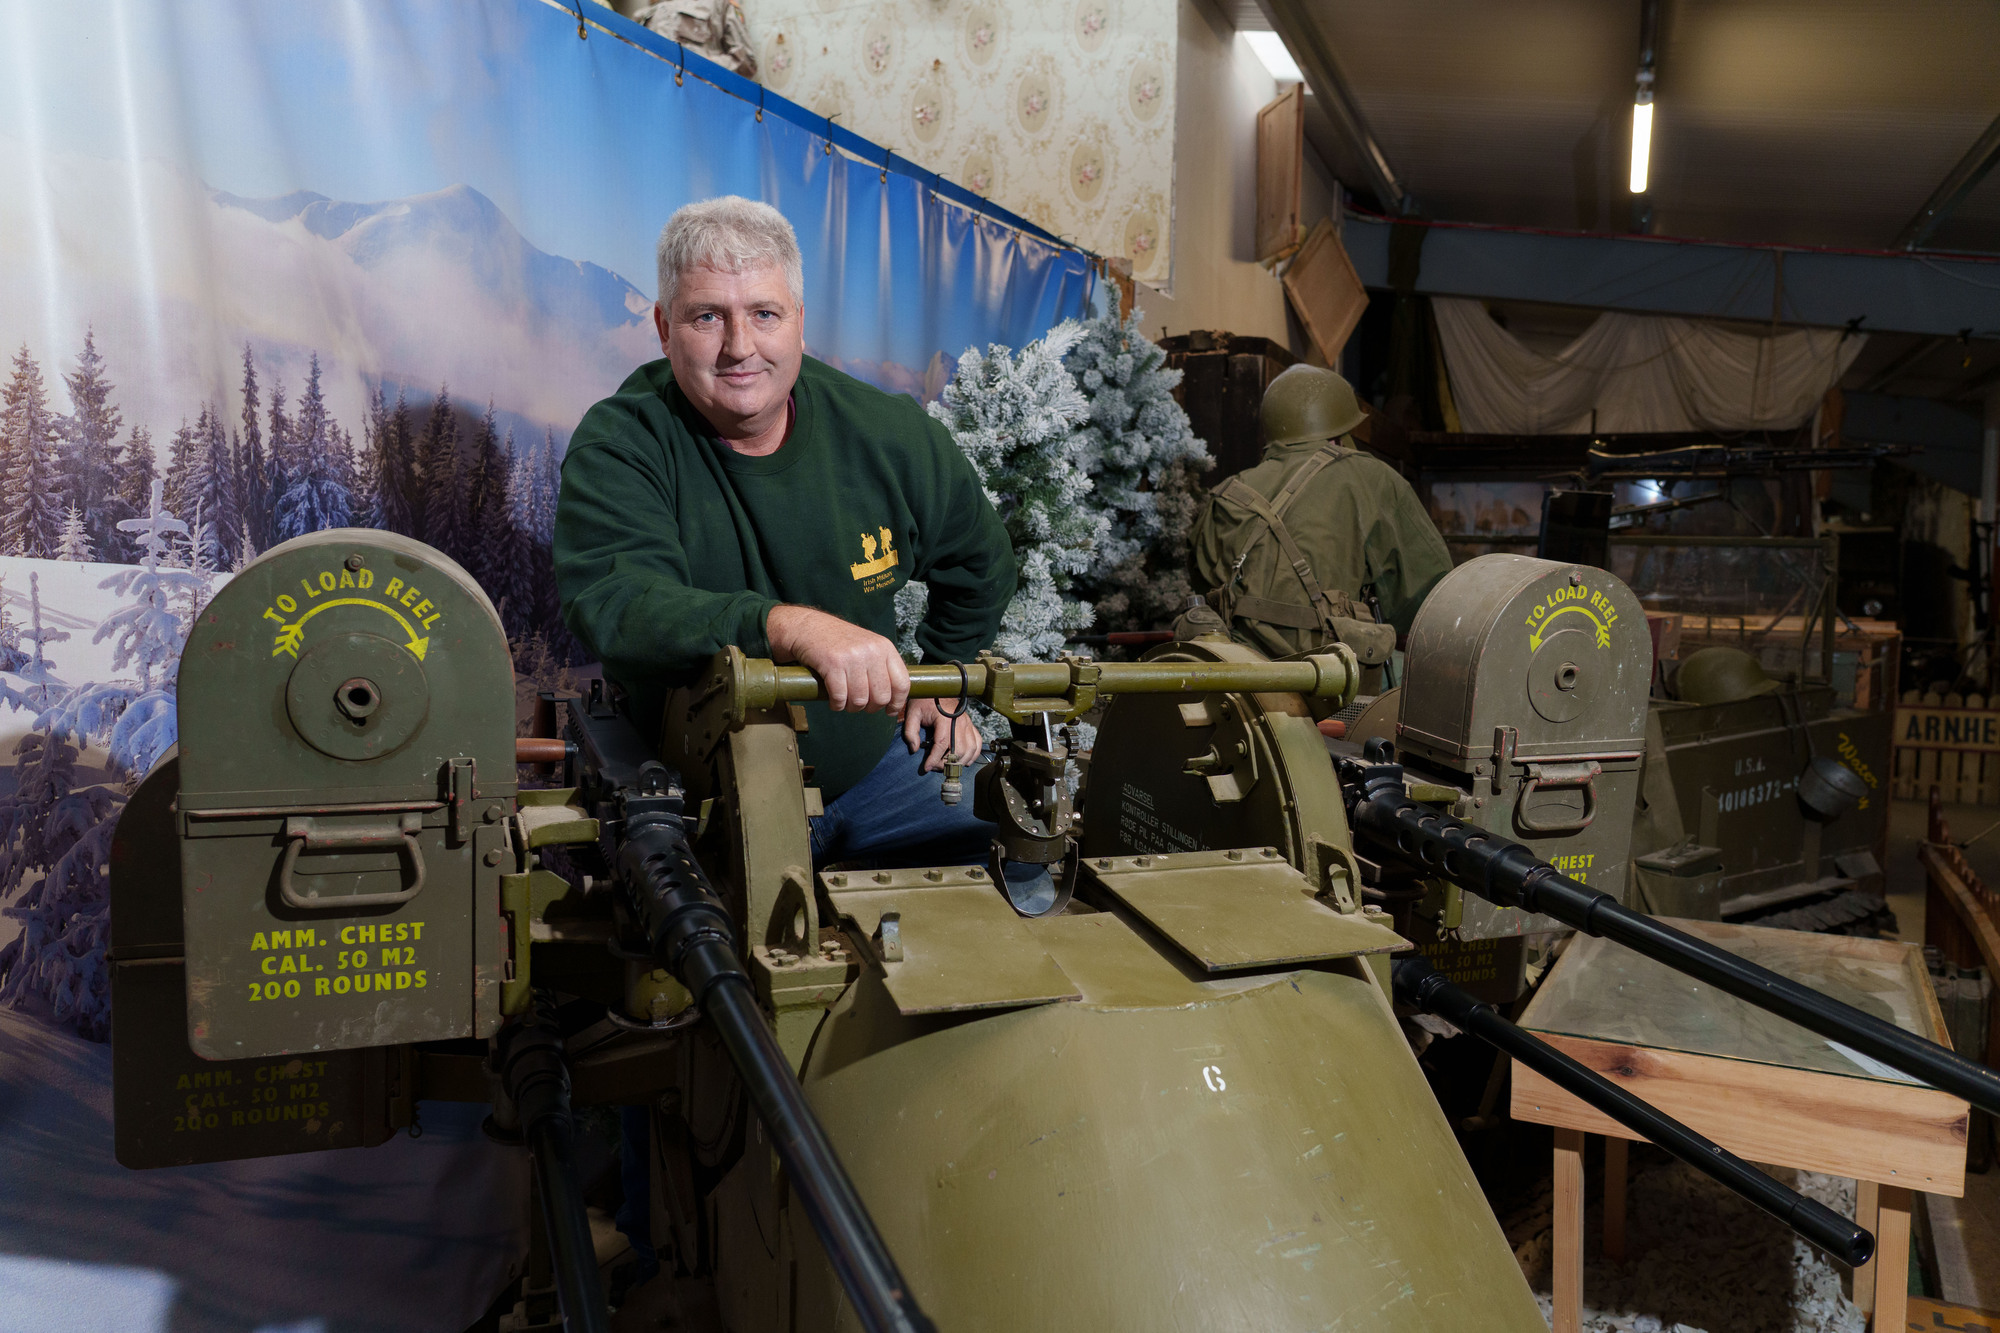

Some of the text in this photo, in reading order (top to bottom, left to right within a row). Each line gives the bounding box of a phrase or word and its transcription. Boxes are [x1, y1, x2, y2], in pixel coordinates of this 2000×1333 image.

[863, 578, 876, 586] Irish
[262, 568, 441, 630] TO LOAD REEL
[1525, 585, 1618, 628] TO LOAD REEL
[1837, 732, 1878, 789] Water
[1122, 782, 1154, 807] ADVARSEL
[1121, 800, 1159, 829] KONTROLLER
[1161, 822, 1198, 850] STILLINGEN
[1139, 825, 1148, 840] PIL
[1150, 833, 1164, 848] PAA
[1549, 854, 1595, 870] CHEST
[250, 922, 425, 951] AMM. CHEST
[1460, 938, 1498, 952] CHEST
[261, 947, 415, 975] CAL. 50 M2
[1432, 953, 1493, 970] AL. 50 M2
[249, 970, 427, 1001] 200 ROUNDS
[176, 1070, 242, 1090] AMM.
[185, 1082, 320, 1109] CAL. 50 M2
[173, 1101, 329, 1132] 200 ROUNDS
